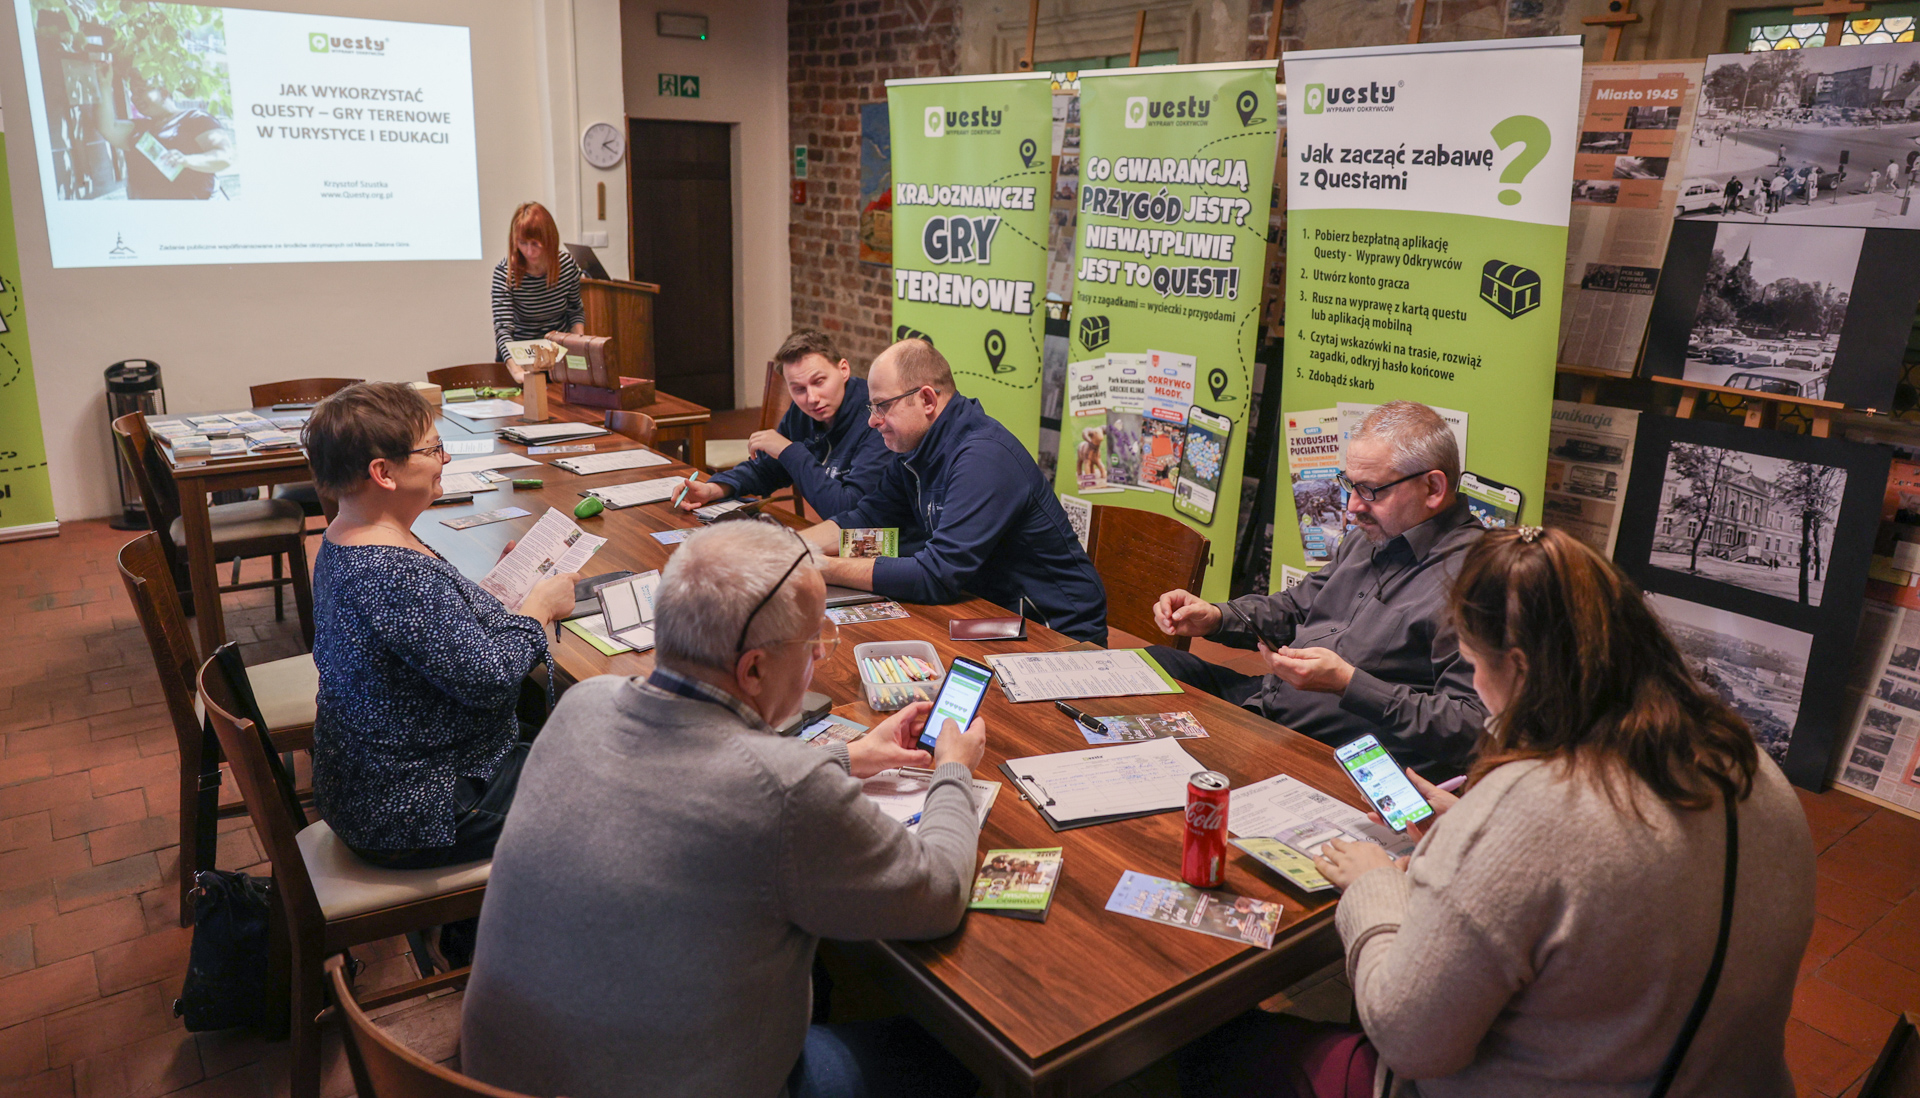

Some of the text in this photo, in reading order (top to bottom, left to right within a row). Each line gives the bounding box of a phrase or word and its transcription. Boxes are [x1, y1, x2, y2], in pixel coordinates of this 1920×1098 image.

[279, 83, 424, 103] JAK WYKORZYSTAĆ
[1596, 88, 1679, 100] Miasto 1945
[251, 103, 314, 119] QUESTY
[333, 107, 364, 120] GRY
[368, 108, 451, 124] TERENOWE
[257, 125, 449, 144] W TURYSTYCE I EDUKACJI
[1300, 143, 1333, 163] Jak
[1340, 143, 1405, 169] zacząć
[1411, 144, 1494, 171] zabawę
[323, 180, 358, 188] Krzysztof
[1086, 155, 1250, 192] CO GWARANCJĄ
[1300, 168, 1408, 190] z Questami
[895, 183, 1036, 211] KRAJOZNAWCZE
[1080, 186, 1252, 226] PRZYGÓD JEST?
[922, 214, 1000, 264] GRY
[1085, 224, 1236, 262] NIEWĄTPLIWIE
[1302, 228, 1449, 254] 1. Pobierz bezpłatną aplikację
[1314, 246, 1346, 262] Questy
[1356, 249, 1401, 268] Wyprawy
[1402, 253, 1463, 271] Odkrywców
[1077, 256, 1240, 301] JEST TO QUEST!
[1300, 268, 1410, 290] 2. Utwórz konto gracza
[895, 269, 1034, 316] TERENOWE
[1077, 291, 1092, 304] Trasy
[1098, 295, 1138, 308] zagadkami
[1147, 301, 1182, 315] wycieczki
[1182, 308, 1187, 316] z
[1188, 308, 1236, 323] przygodami
[1299, 290, 1468, 322] 3. Rusz na wyprawę z kartą questu
[1311, 308, 1413, 335] lub aplikacją mobilną
[1298, 329, 1482, 368] 4. Czytaj wskazówki na trasie, rozwiąż
[1309, 348, 1455, 382] zagadki, odkryj hasło końcowe
[1129, 386, 1145, 394] KLIMA
[1147, 375, 1191, 390] ODKRYWCO
[1296, 367, 1375, 391] 5. Zdobądź skarb
[1071, 390, 1107, 402] jordanowskieg
[1551, 409, 1612, 430] unikacja
[1290, 434, 1338, 446] Z KUBUSIEM
[1185, 801, 1226, 830] Cola
